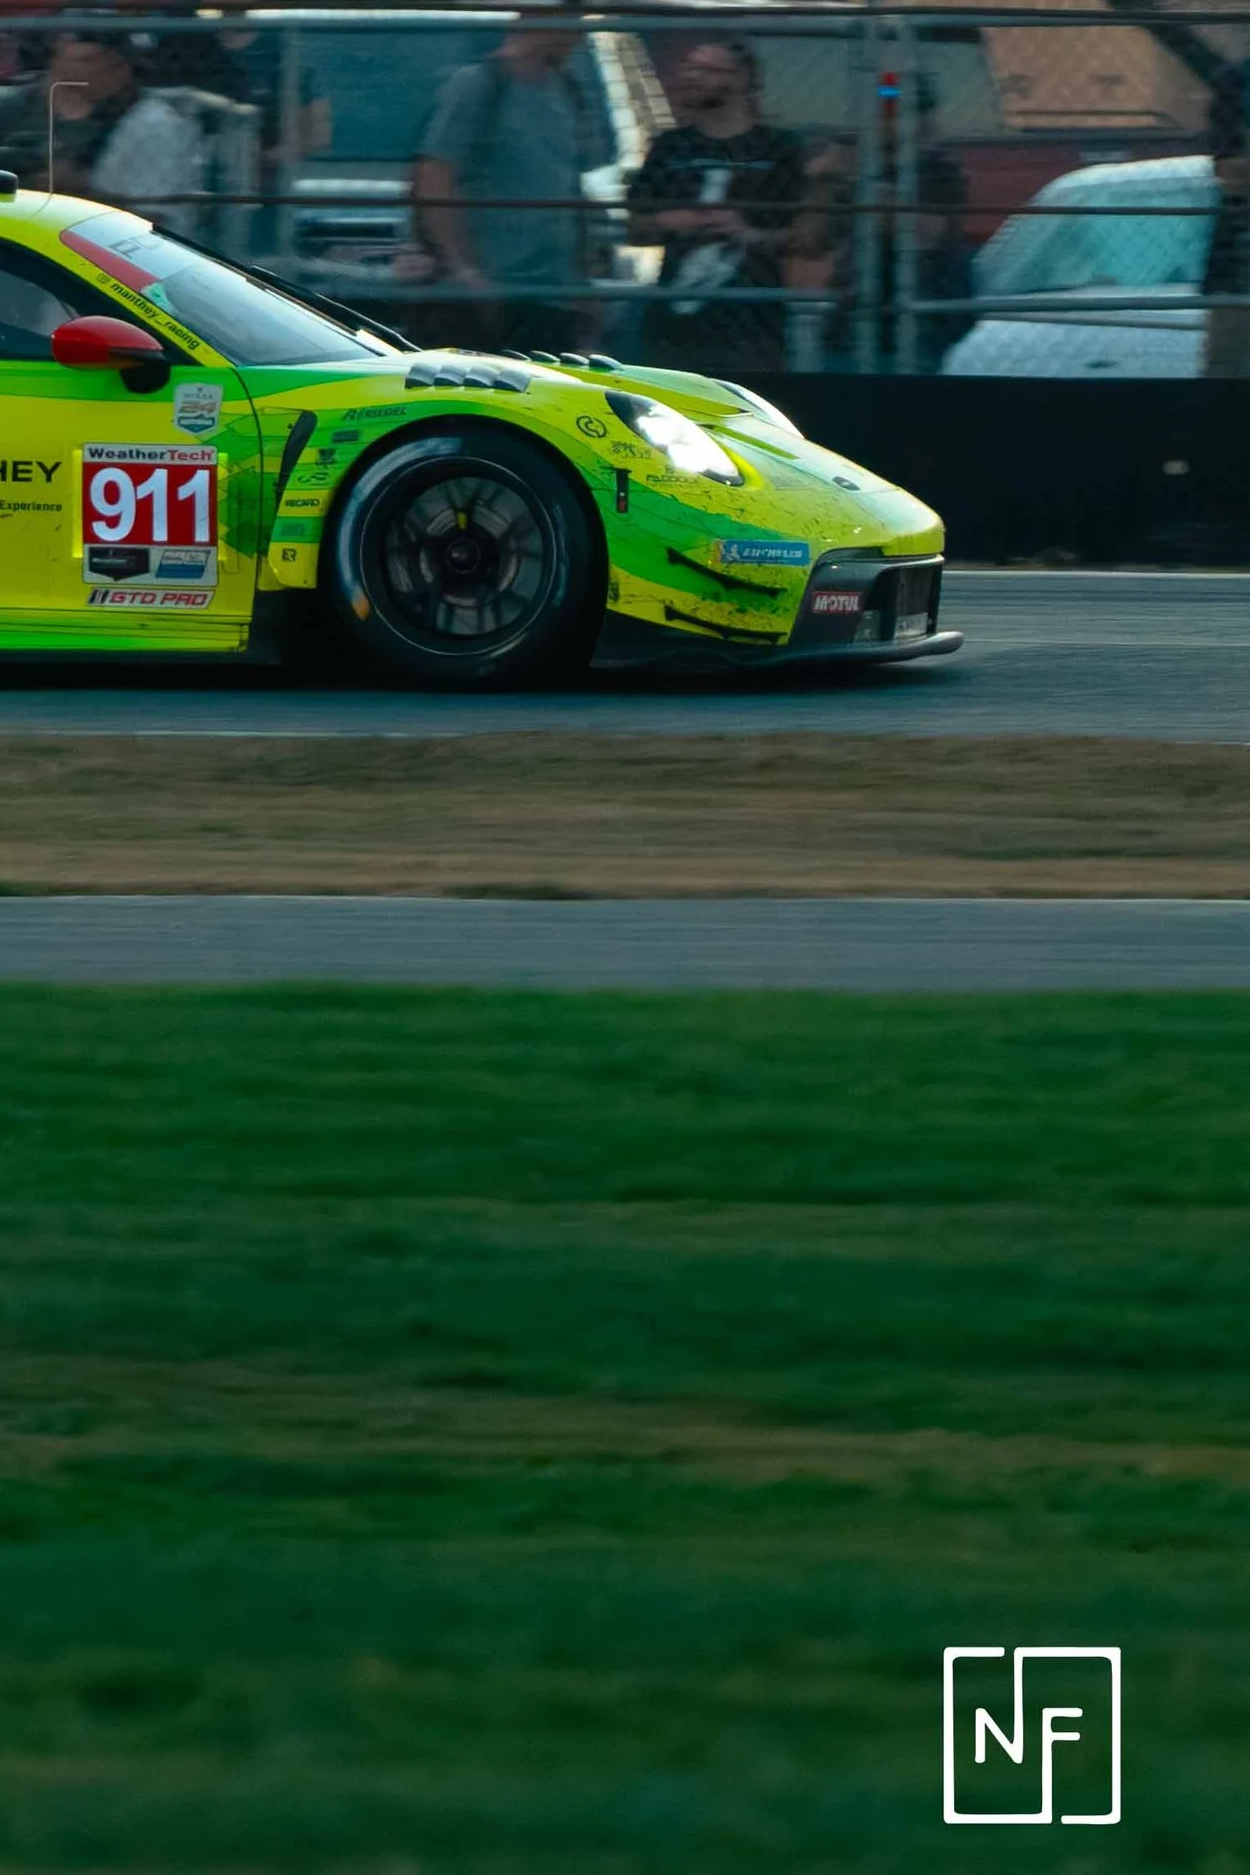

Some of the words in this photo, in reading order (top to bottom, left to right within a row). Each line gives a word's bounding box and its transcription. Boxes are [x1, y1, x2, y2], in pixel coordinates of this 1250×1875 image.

[110, 281, 201, 351] manthey_racing
[88, 447, 214, 461] WeatherTech
[90, 467, 211, 543] 911
[109, 591, 157, 605] GTD
[160, 592, 209, 606] PRO
